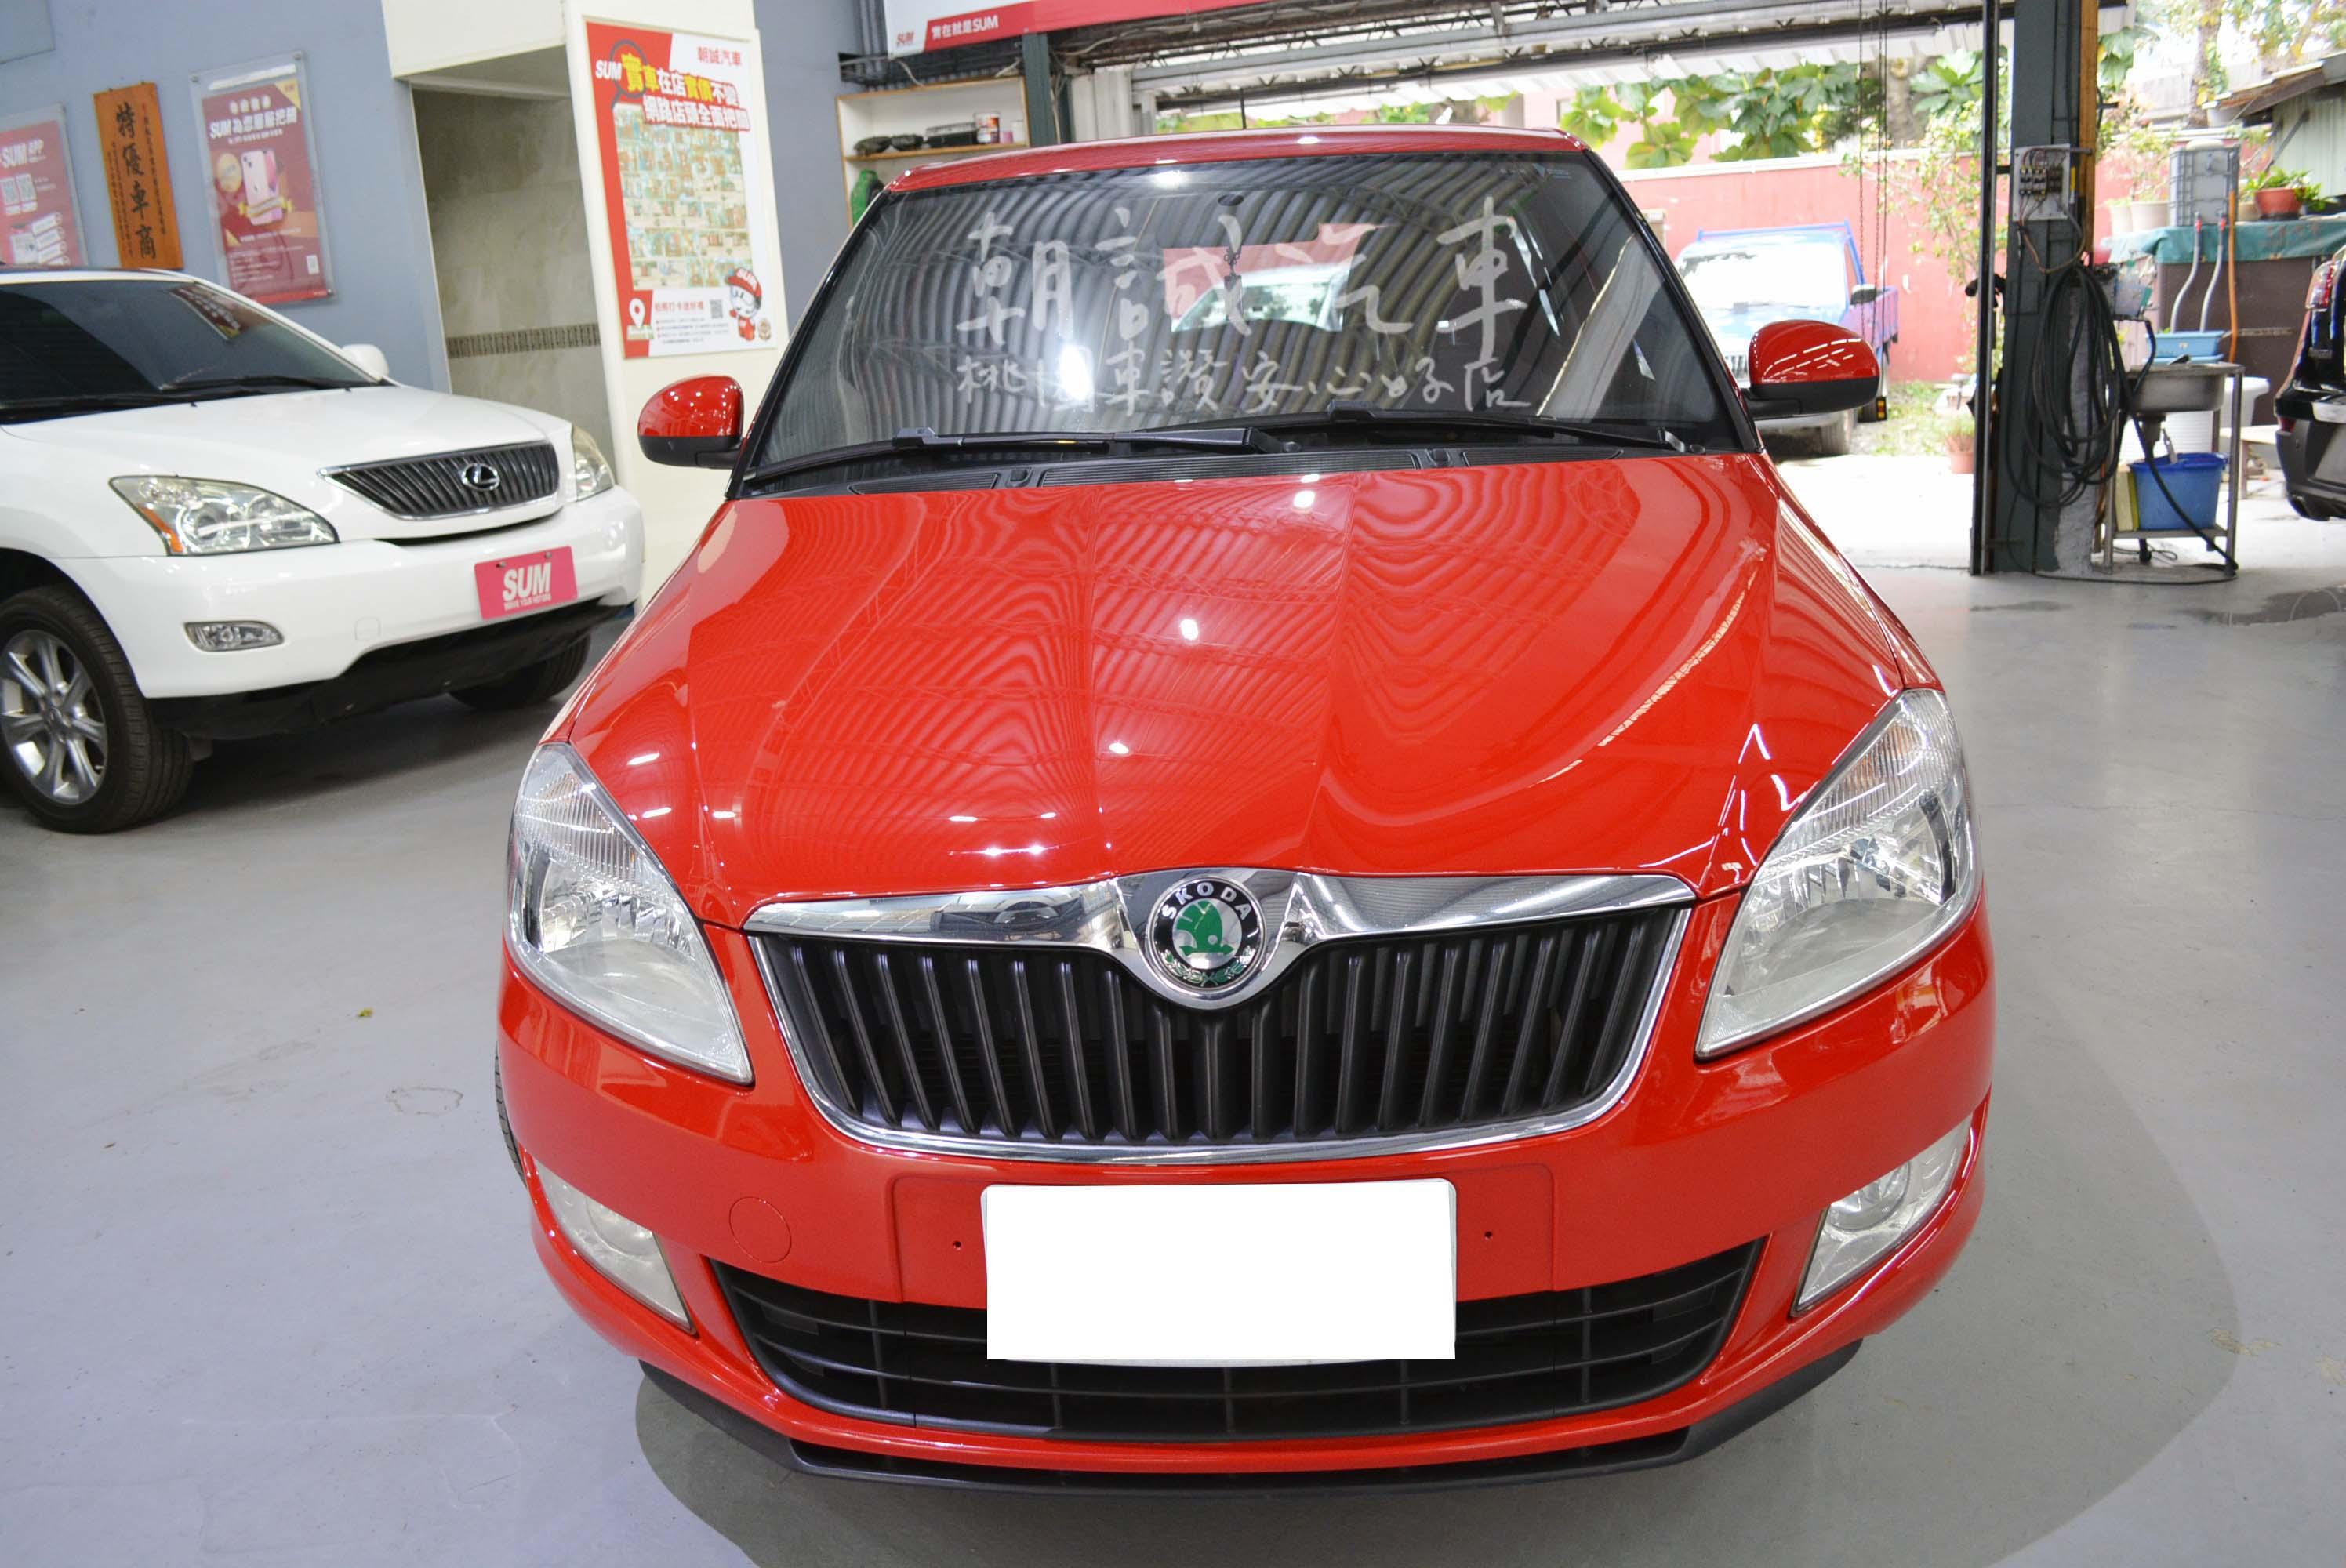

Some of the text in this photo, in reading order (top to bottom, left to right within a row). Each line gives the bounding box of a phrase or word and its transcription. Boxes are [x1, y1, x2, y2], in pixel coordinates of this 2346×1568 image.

[697, 45, 742, 67] 朝誠汽車
[595, 59, 623, 81] SUM
[503, 561, 552, 601] SUM
